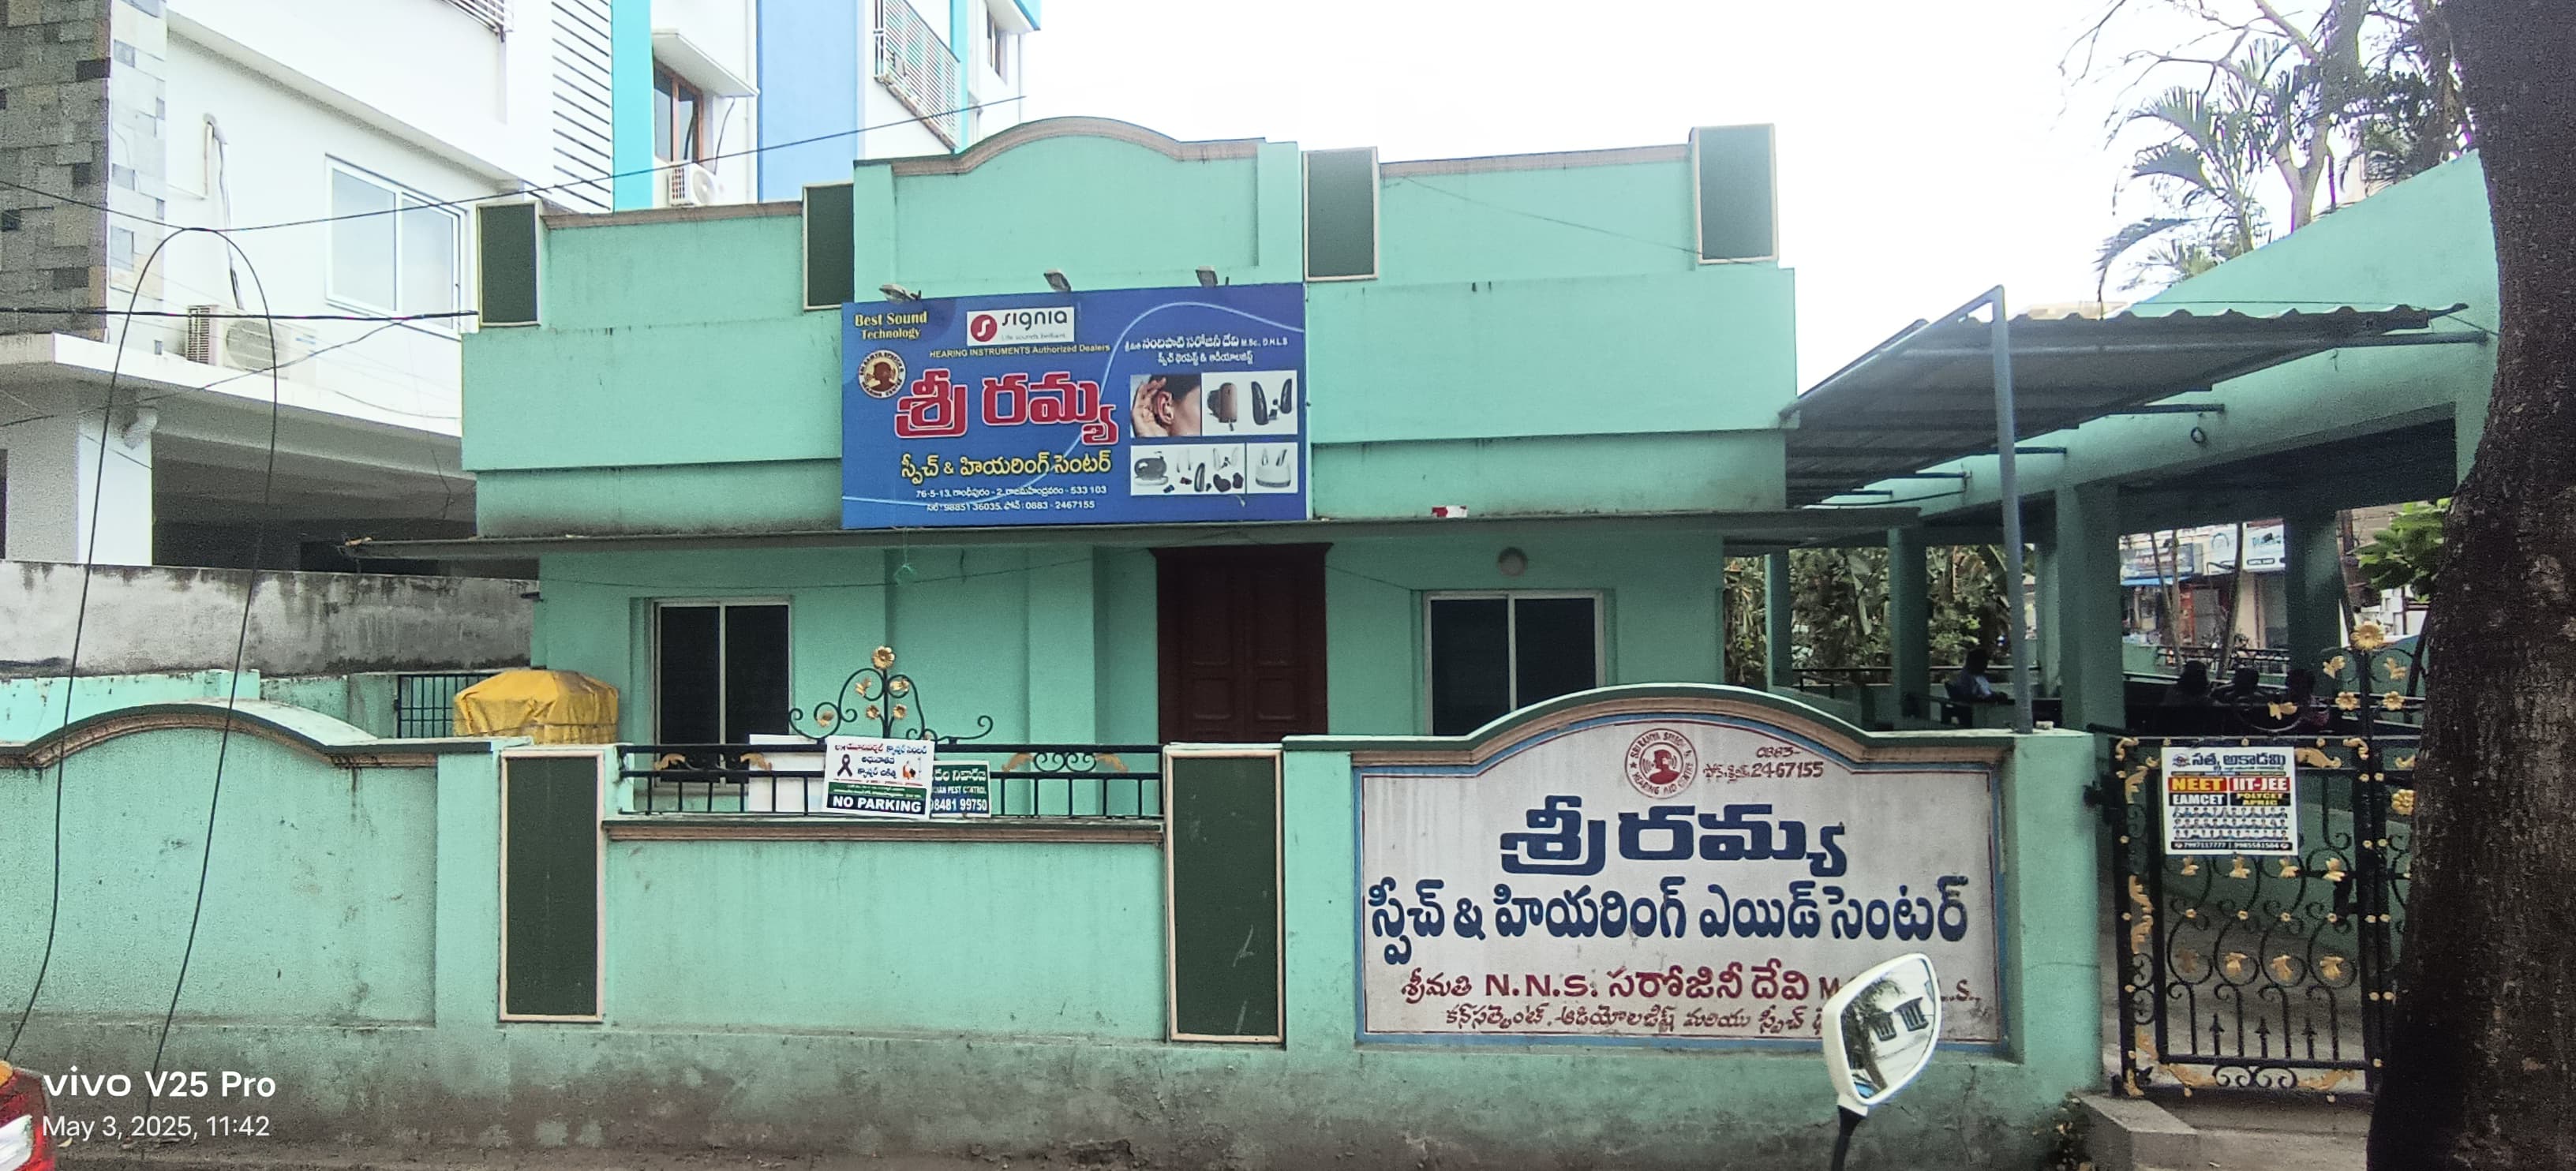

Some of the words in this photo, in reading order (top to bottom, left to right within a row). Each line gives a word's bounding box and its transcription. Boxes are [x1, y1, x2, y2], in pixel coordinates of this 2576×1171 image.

[855, 313, 882, 327] Best
[886, 310, 927, 325] Sound
[1002, 310, 1068, 331] signia
[861, 327, 922, 340] Technology
[969, 346, 1030, 356] INSTRUMENTS
[1032, 344, 1077, 353] Authorized
[1079, 342, 1110, 352] Dealers
[895, 369, 968, 438] శ్రీ
[981, 371, 1119, 445] రమ్య
[901, 453, 939, 485] స్పీచ్
[943, 461, 954, 475] &
[960, 451, 1050, 477] హియరింగ్
[1054, 450, 1111, 473] సెంటర్
[1070, 486, 1088, 495] 533
[1091, 485, 1107, 495] 103
[1025, 501, 1048, 510] 0883
[1055, 500, 1095, 510] 2467155
[2172, 778, 2223, 791] NEET
[2233, 778, 2288, 791] IIT-JEE
[833, 795, 854, 807] NO
[857, 799, 922, 813] PARKING
[960, 799, 987, 811] 99750
[2173, 794, 2224, 805] EAMCET
[1500, 795, 1606, 877] శ్రీ
[1618, 803, 1847, 877] రమ్య
[1368, 876, 1445, 965] స్పీచ్
[1453, 897, 1486, 941] &
[1493, 875, 1687, 939] హియరింగ్
[1698, 880, 1821, 939] ఎయిడ్
[1822, 875, 1969, 942] సెంటర్
[1401, 967, 1472, 1004] శ్రీమతి
[1606, 960, 1743, 999] సరోజినీ
[1750, 957, 1810, 1001] దేవి
